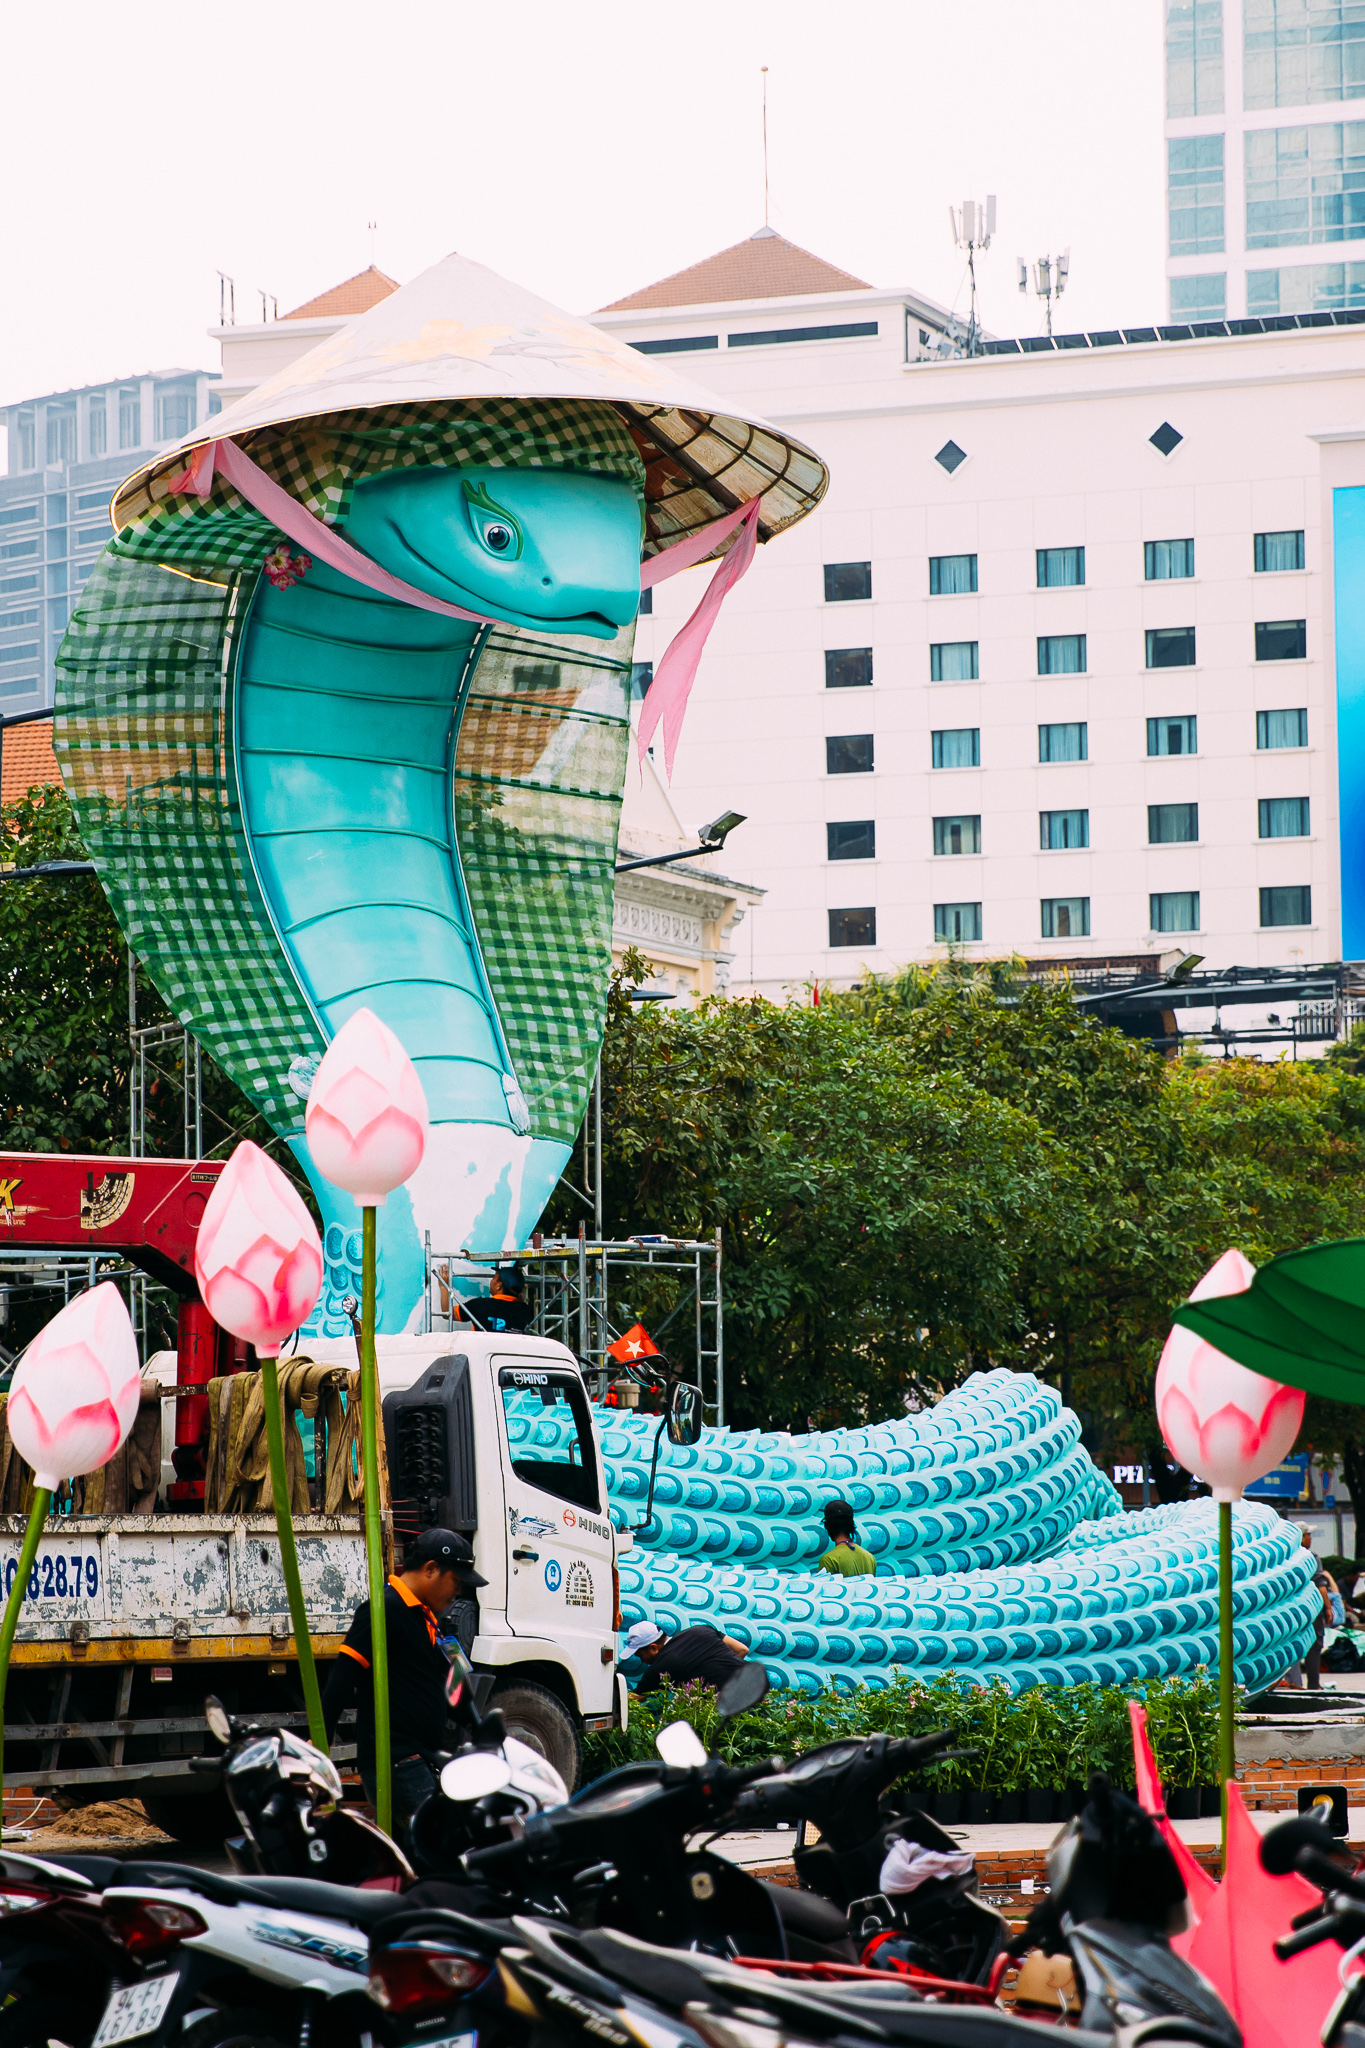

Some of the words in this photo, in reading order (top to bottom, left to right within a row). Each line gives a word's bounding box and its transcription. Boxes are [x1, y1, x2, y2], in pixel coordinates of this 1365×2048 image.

[523, 1373, 548, 1385] HINO
[579, 1516, 610, 1540] HINO
[114, 1978, 166, 2015] 94-F1
[415, 2017, 446, 2029] HONDA
